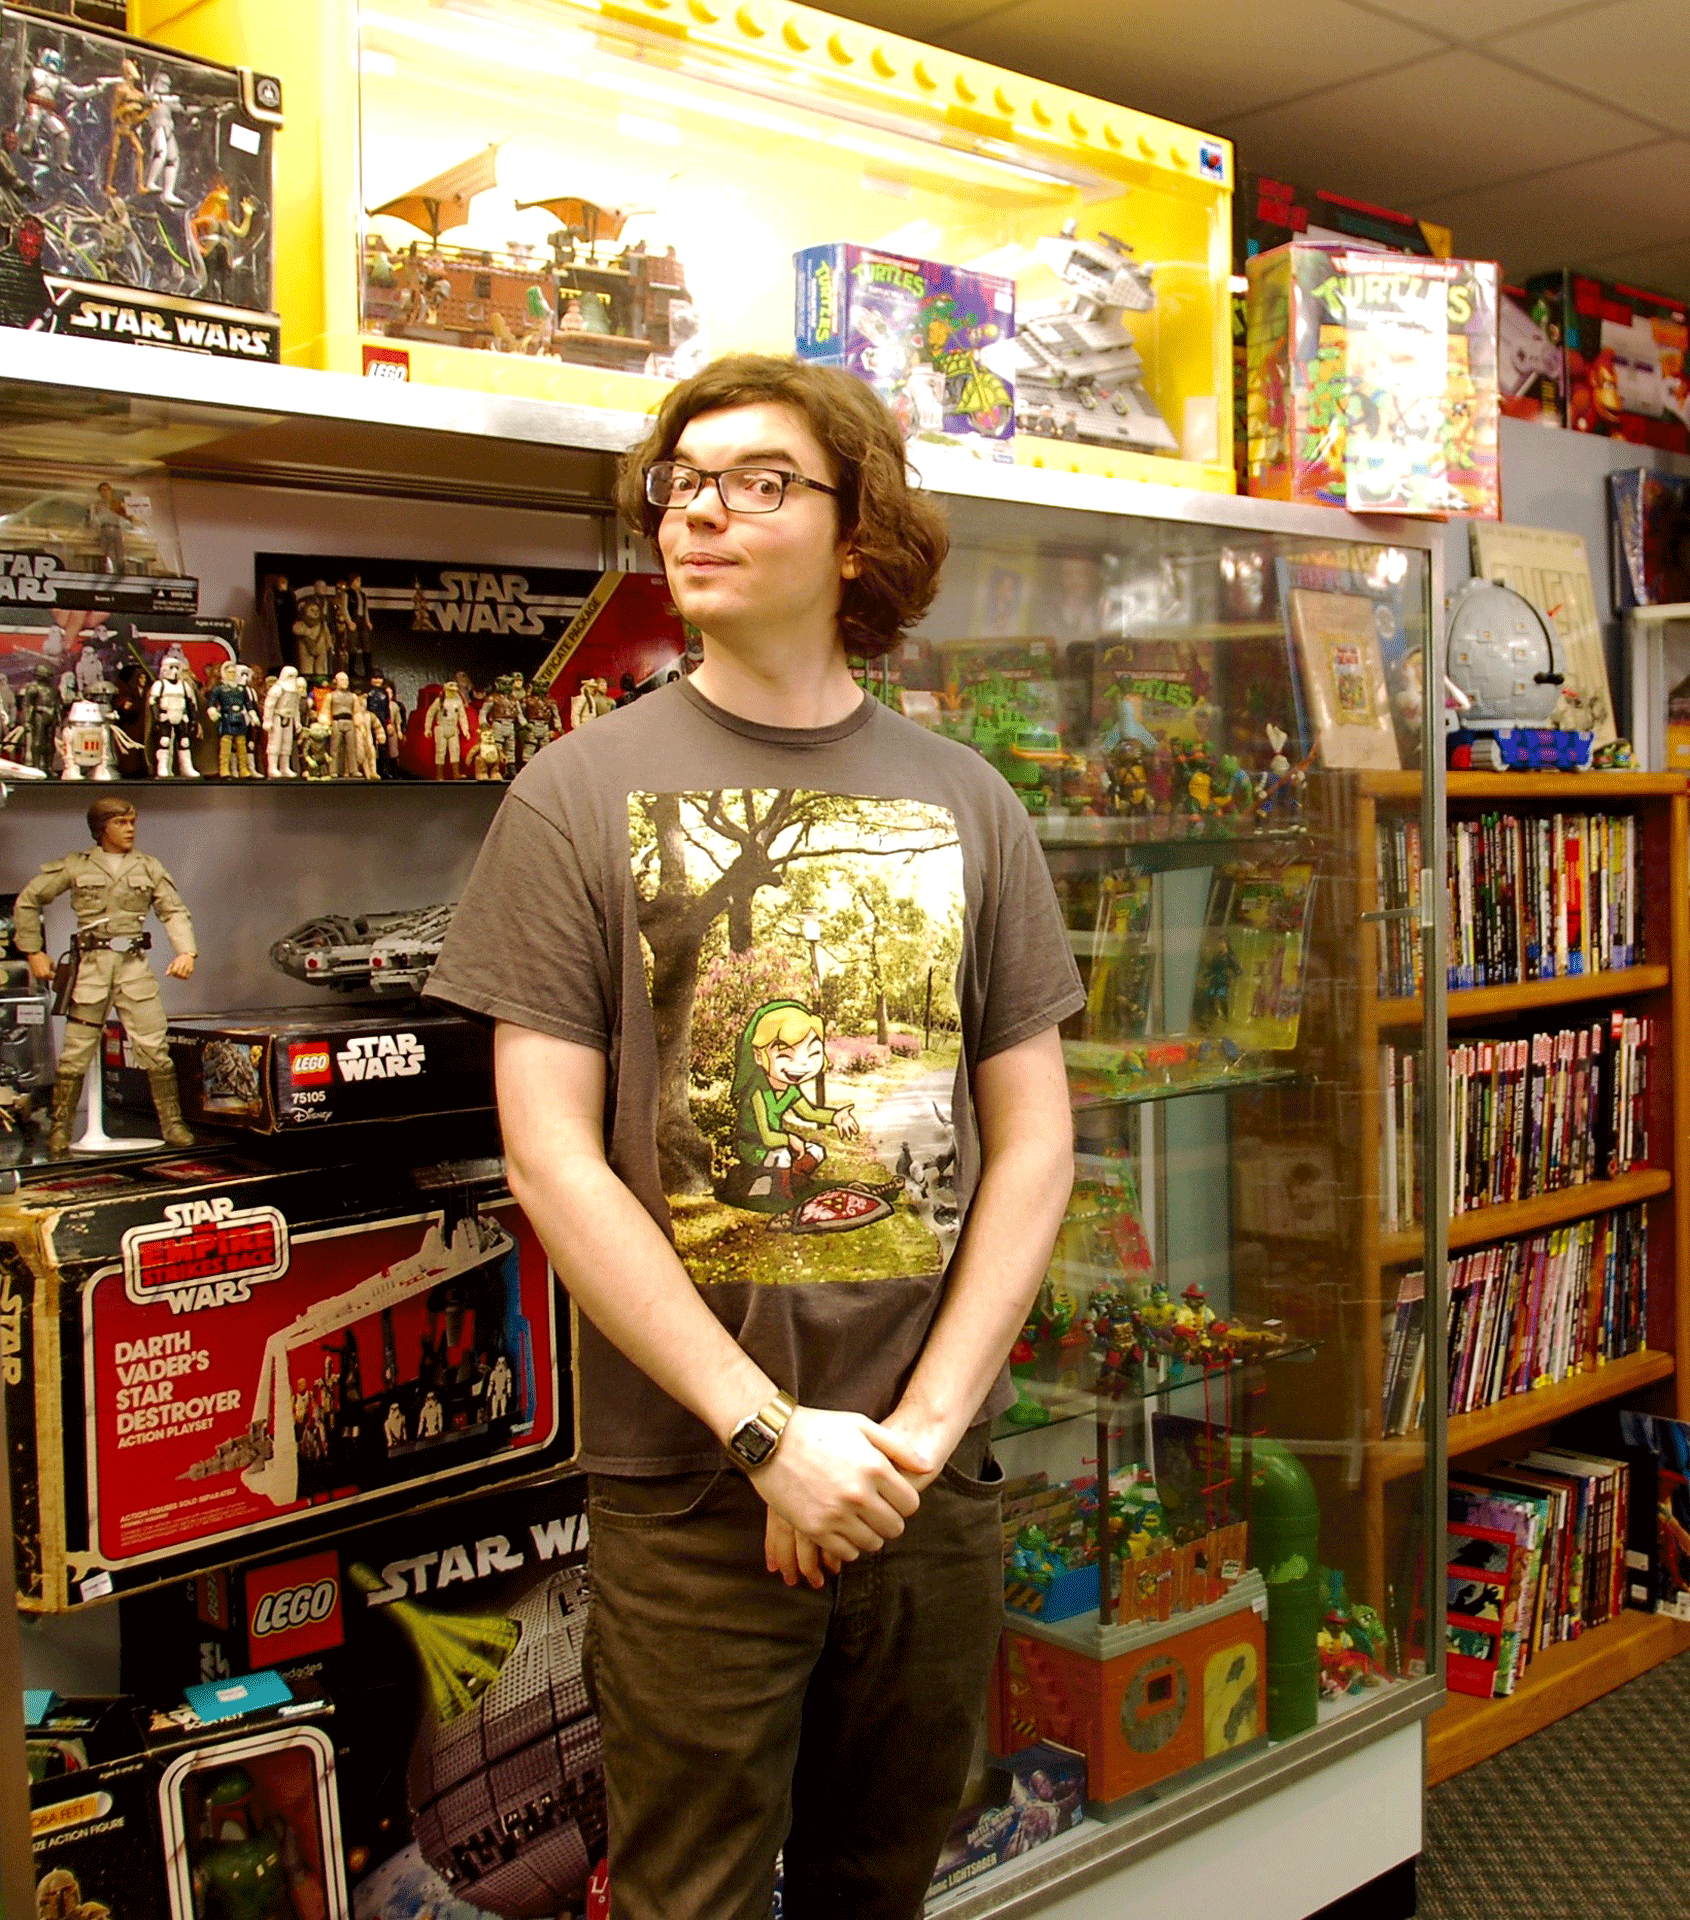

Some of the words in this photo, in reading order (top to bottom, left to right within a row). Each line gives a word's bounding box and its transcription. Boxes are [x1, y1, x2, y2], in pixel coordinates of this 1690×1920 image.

[70, 301, 173, 341] STAR
[175, 316, 271, 357] WARS
[0, 553, 58, 579] TAR
[0, 577, 58, 602] ARS
[439, 571, 530, 604] STAR
[434, 602, 545, 636] WARS
[539, 637, 571, 685] TIFICATE
[568, 597, 599, 643] PACKAGE
[336, 1033, 425, 1061] STAR
[295, 1054, 328, 1073] LEGO
[337, 1053, 426, 1082] WARS
[291, 1090, 326, 1104] 75105
[291, 1106, 333, 1123] Disney
[164, 1197, 235, 1227] STAR
[139, 1222, 274, 1266] EMPIRE
[141, 1256, 224, 1287] STRIKES
[166, 1281, 251, 1315] WARS
[115, 1330, 191, 1364] DARTH
[116, 1349, 210, 1386] VADER'S
[116, 1381, 174, 1411] STAR
[117, 1389, 241, 1435] DESTROYER
[117, 1428, 165, 1449] ACTION
[166, 1417, 214, 1438] PLAYSET
[366, 1534, 525, 1608] STAR
[255, 1582, 333, 1634] LEGO
[32, 1811, 58, 1829] OBA
[32, 1840, 47, 1853] IZE
[48, 1828, 89, 1848] ACTION
[90, 1815, 126, 1836] FIGURE
